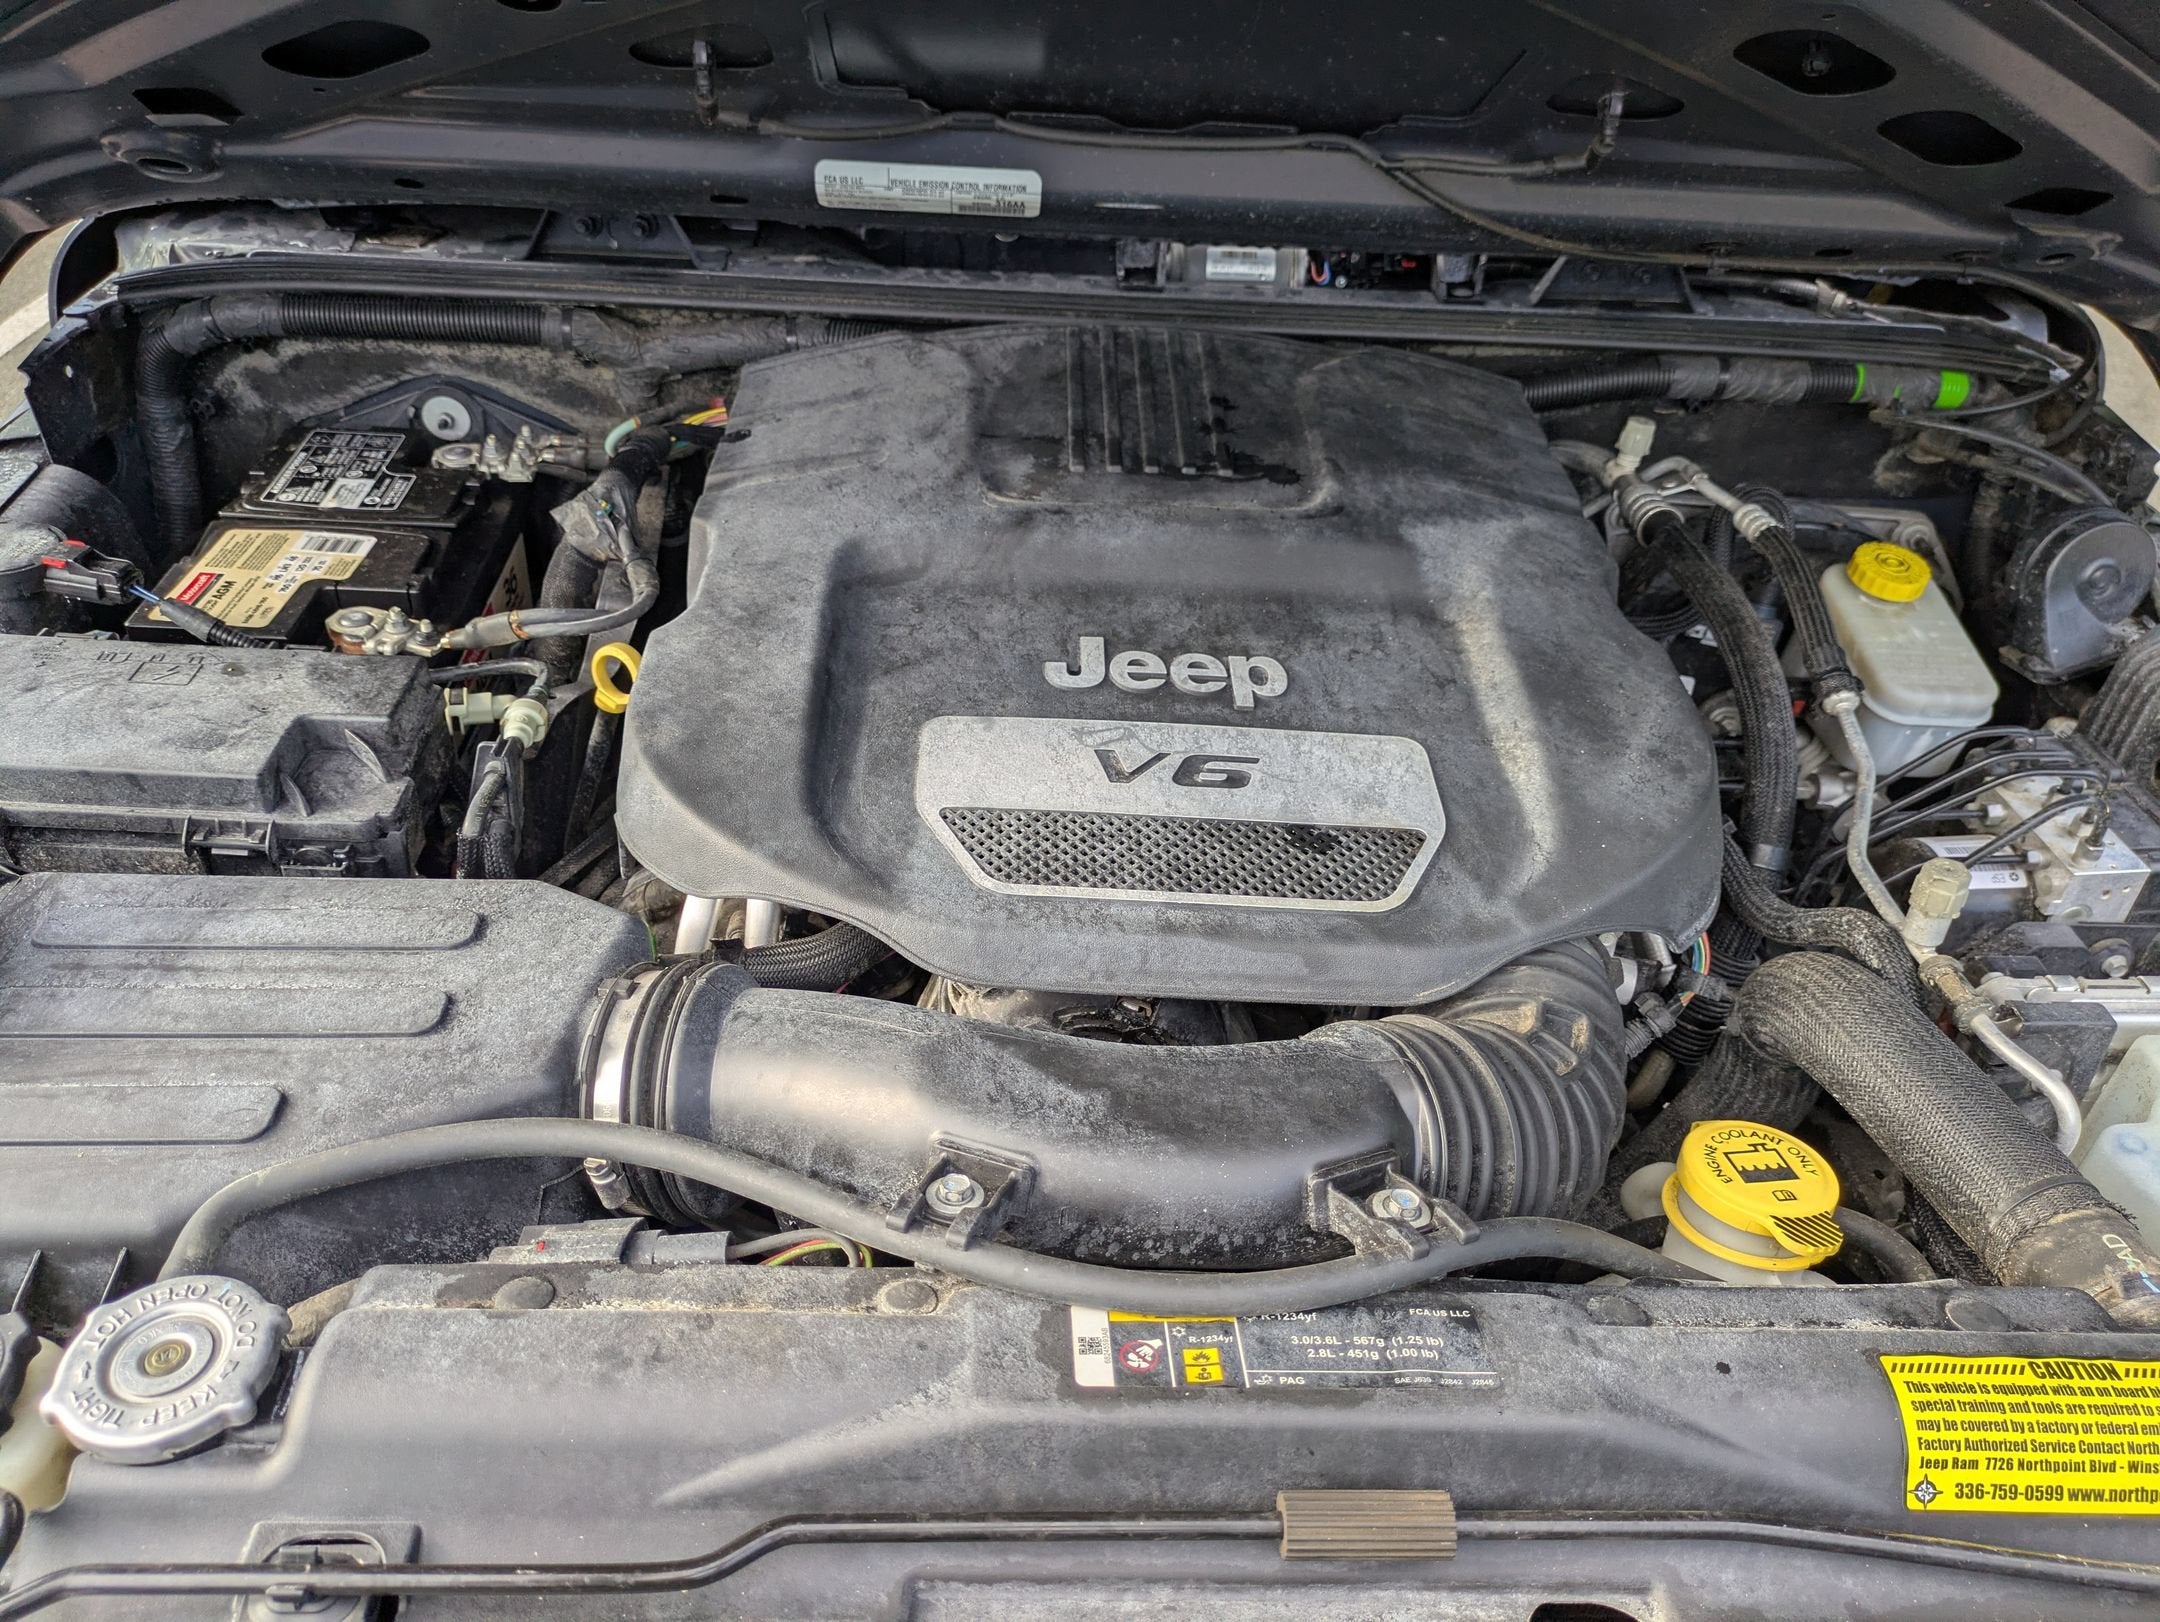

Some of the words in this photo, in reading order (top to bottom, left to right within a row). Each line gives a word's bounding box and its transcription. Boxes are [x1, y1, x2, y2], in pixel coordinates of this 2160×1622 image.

[824, 175, 838, 184] FCA
[840, 175, 849, 185] US
[890, 179, 917, 188] VEHICLE
[918, 180, 950, 190] EMISSION
[952, 182, 980, 191] CONTROL
[983, 183, 1027, 193] INFORMATION
[212, 580, 237, 600] AGM
[1044, 636, 1288, 711] Jeep
[1094, 749, 1260, 789] V6
[1711, 1129, 1784, 1146] COOLANT
[1704, 1143, 1733, 1184] ENGINE
[1787, 1146, 1819, 1176] ONLY
[136, 1283, 209, 1313] OPEN
[209, 1288, 253, 1320] NOT
[1408, 1308, 1431, 1316] FCA
[1432, 1309, 1448, 1317] US
[1449, 1310, 1471, 1318] LLC
[83, 1307, 134, 1350] HOT
[236, 1319, 257, 1351] DO
[1188, 1334, 1233, 1344] R-1234yf
[1290, 1335, 1341, 1345] 3.0/3.6L
[1353, 1336, 1385, 1347] 567g
[1392, 1336, 1424, 1347] (1.25
[1426, 1336, 1444, 1348] lb)
[1307, 1348, 1337, 1358] 2.8L
[1347, 1348, 1380, 1360] 451g
[1386, 1348, 1418, 1360] (1.00
[1421, 1349, 1439, 1361] lb)
[2027, 1360, 2123, 1381] CAUTION
[1279, 1376, 1305, 1385] PAG
[1394, 1377, 1412, 1385] SAE
[1903, 1380, 1932, 1394] This
[1931, 1381, 1978, 1394] vehicle
[1977, 1382, 1991, 1395] is
[1992, 1382, 2049, 1397] equipped
[2049, 1383, 2078, 1397] with
[2078, 1385, 2095, 1397] an
[2095, 1386, 2112, 1398] on
[2111, 1385, 2150, 1399] board
[71, 1386, 125, 1429] TIGHT
[139, 1384, 219, 1428] KEEP
[1911, 1399, 1957, 1413] special
[1957, 1399, 2006, 1415] training
[2007, 1400, 2031, 1413] and
[2031, 1401, 2064, 1414] tools
[2065, 1403, 2086, 1415] are
[2087, 1402, 2140, 1417] required
[2140, 1404, 2155, 1416] to
[1916, 1419, 1941, 1433] may
[1942, 1417, 1958, 1431] be
[1960, 1419, 2009, 1432] covered
[2010, 1419, 2025, 1434] by
[2026, 1421, 2035, 1433] a
[2036, 1419, 2079, 1436] factory
[2081, 1422, 2094, 1435] or
[2095, 1420, 2139, 1436] federal
[2140, 1424, 2160, 1436] em
[1917, 1436, 1961, 1452] Factory
[1964, 1437, 2028, 1452] Authorized
[2030, 1439, 2076, 1453] Service
[2079, 1439, 2126, 1454] Contact
[2127, 1440, 2160, 1455] North
[1919, 1456, 1948, 1471] Jeep
[1951, 1457, 1979, 1470] Ram
[1985, 1457, 2014, 1471] 7726
[2017, 1457, 2086, 1473] Northpoint
[2089, 1459, 2117, 1473] Blvd
[2127, 1460, 2160, 1474] Wins
[1954, 1482, 2064, 1501] 336-759-0599
[2067, 1486, 2160, 1504] www.northp
